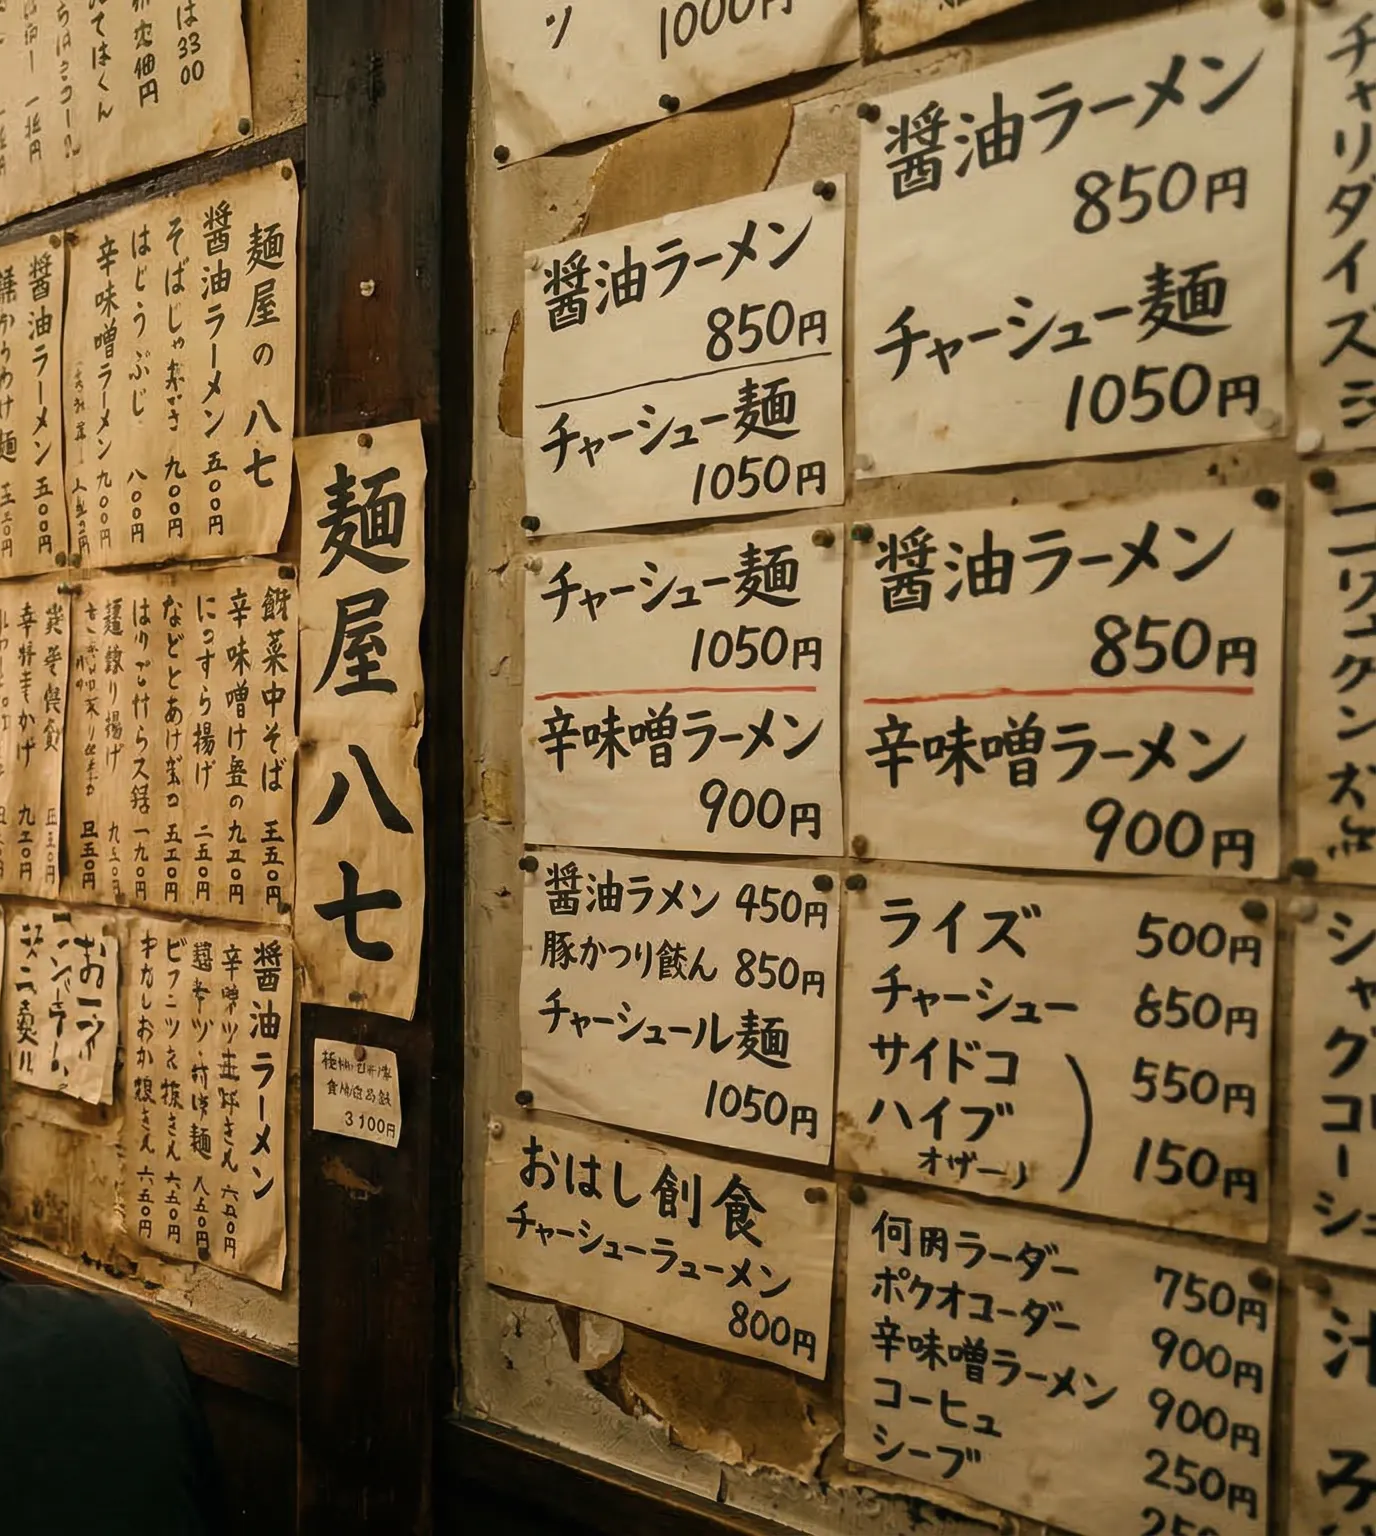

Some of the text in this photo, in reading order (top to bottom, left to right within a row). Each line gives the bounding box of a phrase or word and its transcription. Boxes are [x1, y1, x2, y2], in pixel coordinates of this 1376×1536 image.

[885, 47, 1266, 201] 醤油ラーメン
[1073, 160, 1248, 235] 850円
[542, 214, 814, 333] 醤油ラーメン
[94, 233, 120, 461] 辛味噌ラーメン
[201, 199, 233, 439] 醤油ラーメン
[243, 222, 286, 488] 麺屋の 八七
[705, 299, 828, 362] 850円
[874, 259, 1233, 382] チャーシュー麺
[28, 252, 53, 467] 醤油ラーメン
[1065, 362, 1261, 432] 1050円
[540, 376, 801, 474] チャーシュー麺
[691, 454, 827, 506] 1050円
[540, 541, 802, 623] チャーシュー麺
[874, 519, 1235, 615] 醤油ラーメン
[690, 624, 823, 672] 1050円
[1089, 613, 1258, 678] 850円
[312, 462, 413, 963] 麺屋八七
[537, 701, 824, 773] 辛味噌ラーメン
[865, 711, 1247, 789] 辛味噌ラーメン
[699, 777, 822, 840] 900円
[1085, 796, 1256, 871] 900円
[543, 860, 829, 931] 醤油ラメン 450円
[879, 896, 1263, 969] ライズ 500円
[734, 947, 826, 999] 850円
[870, 962, 1080, 1025] チャーシュー
[537, 987, 793, 1069] チャーシュール麺
[249, 938, 284, 1201] 醤油ラーメン
[868, 1031, 1257, 1119] サイドコ 550円
[704, 1079, 819, 1140] 1050円
[866, 1096, 1259, 1204] ハイブ 150円
[727, 1299, 818, 1364] 800円
[1153, 1264, 1268, 1333] 750円
[870, 1315, 1261, 1459] 辛味噌ラーメン 900円
[1150, 1326, 1264, 1395] 900円
[872, 1375, 1259, 1521] コーヒュ 250円
